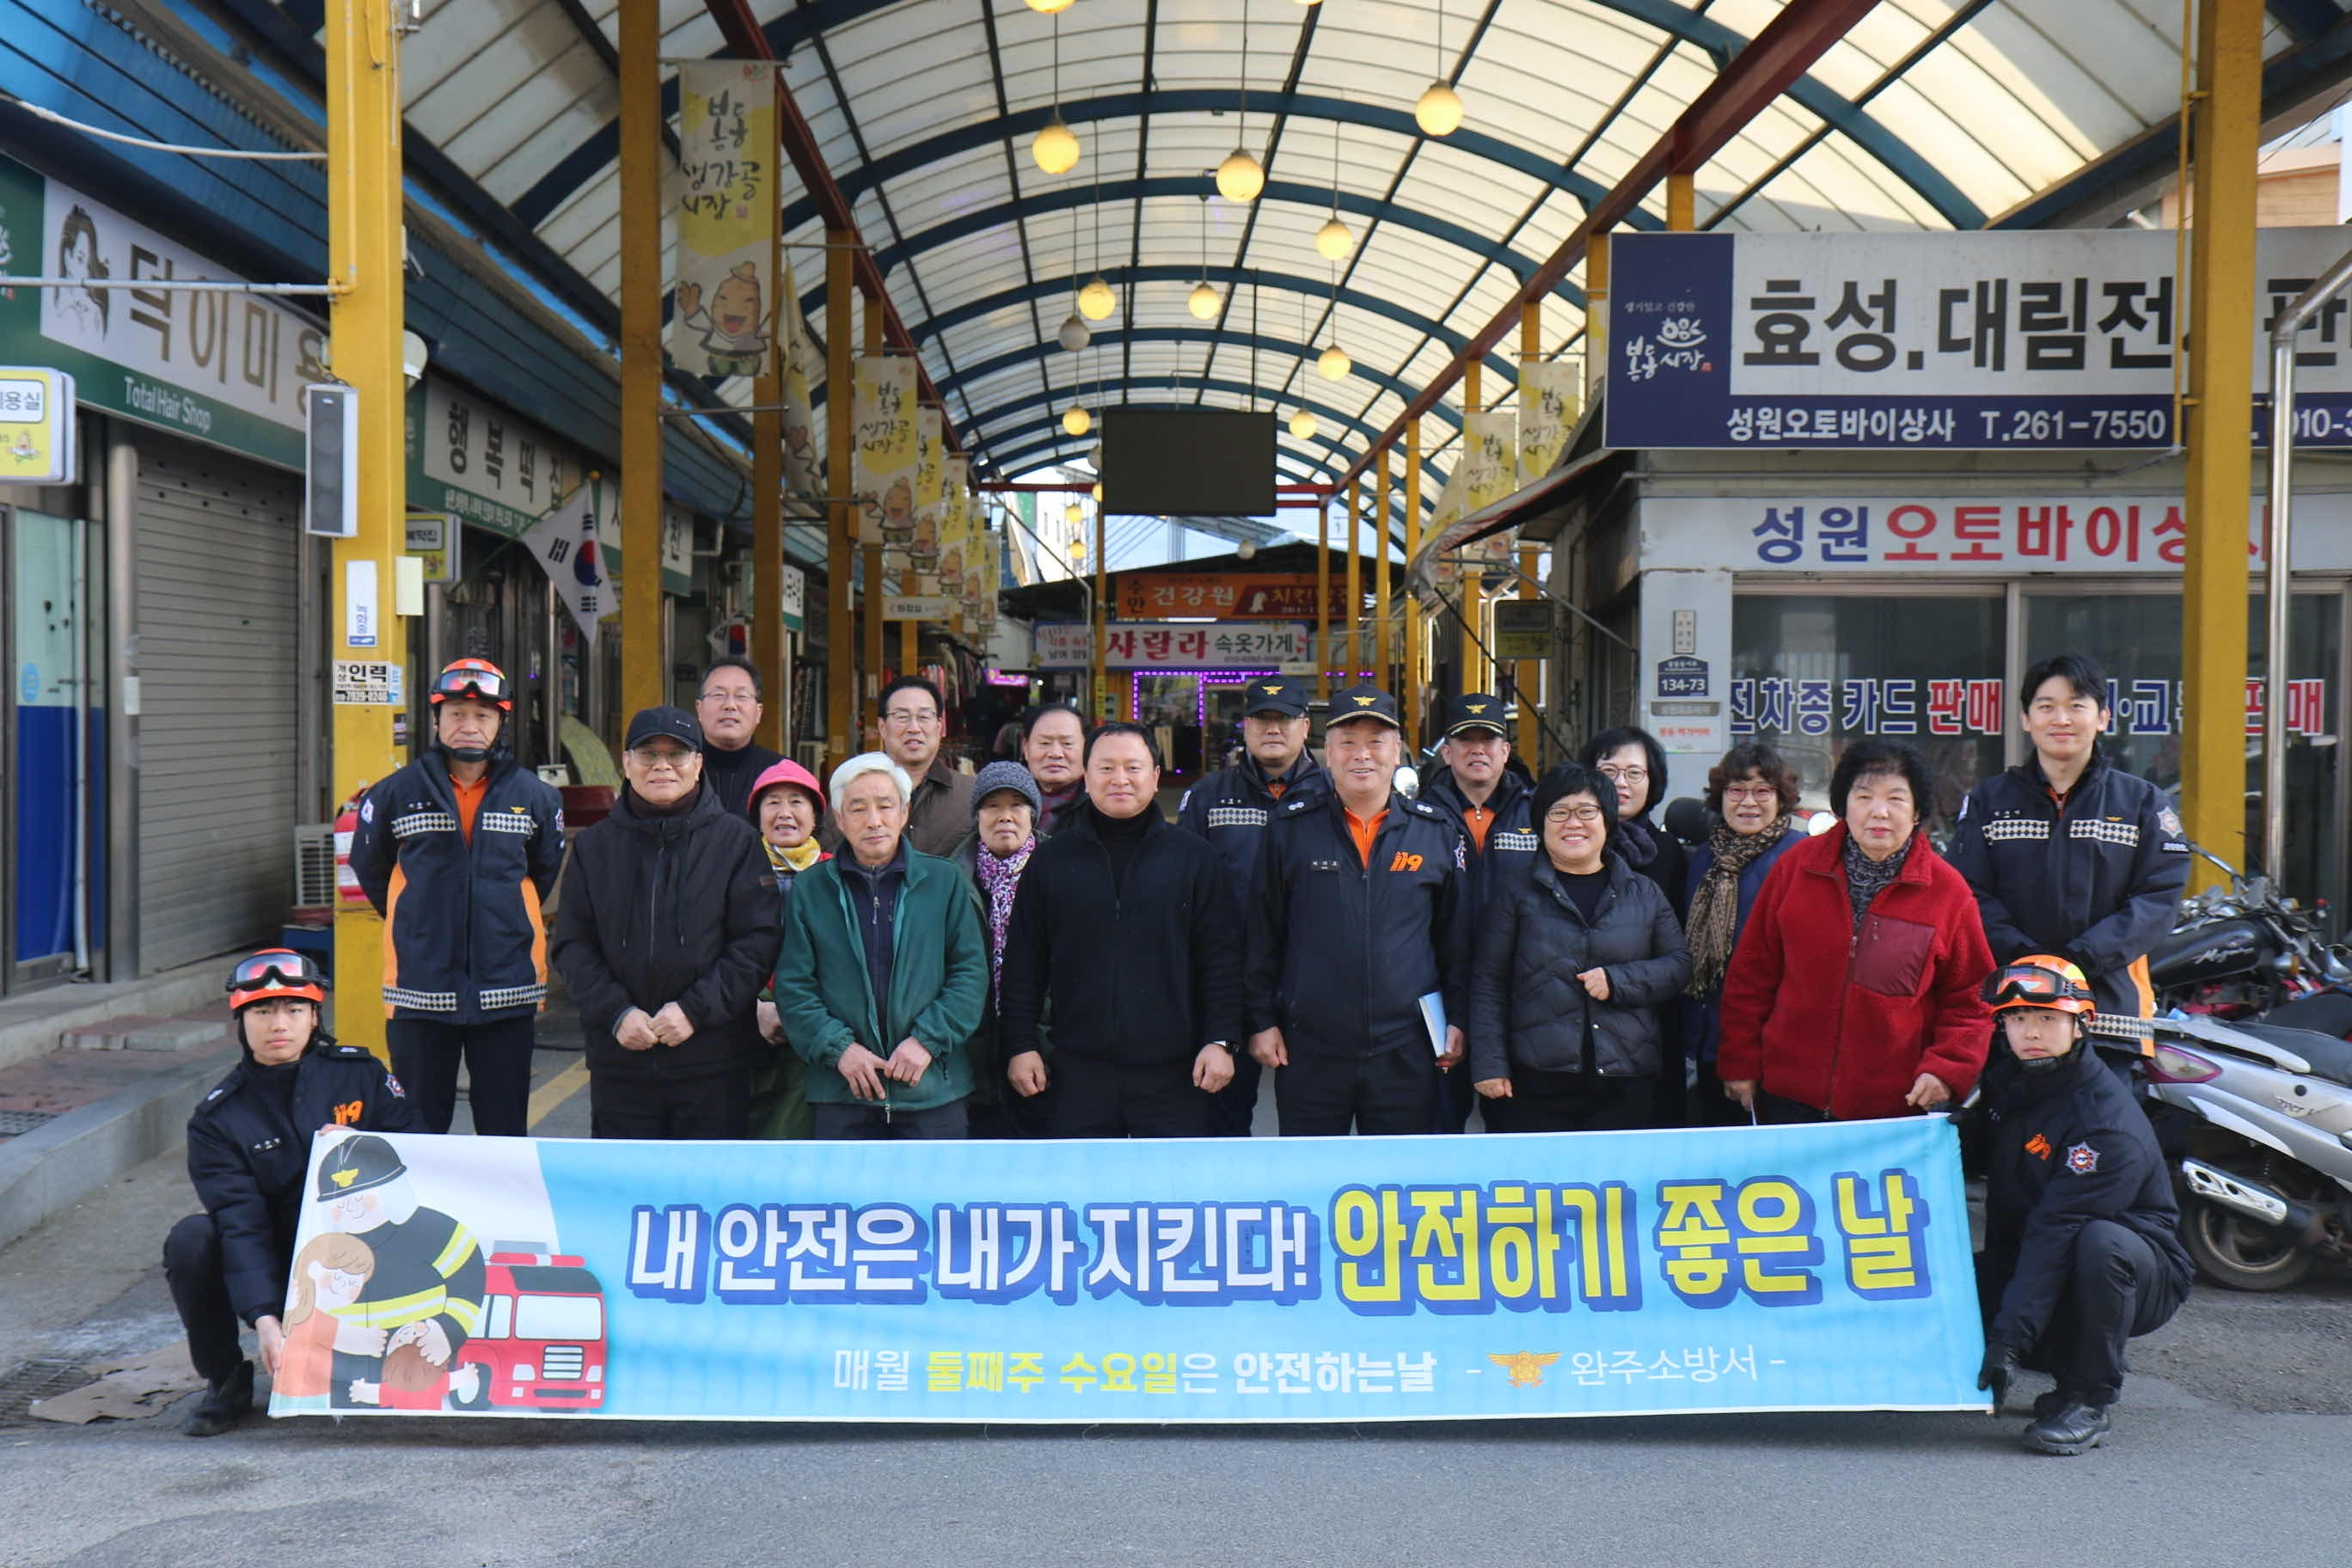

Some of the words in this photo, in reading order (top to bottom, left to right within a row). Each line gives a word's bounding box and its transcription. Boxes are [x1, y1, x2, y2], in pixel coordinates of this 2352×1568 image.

[682, 160, 762, 200] 생강골
[682, 193, 732, 221] 시장
[0, 390, 41, 413] 용실
[124, 376, 160, 411] Total
[159, 388, 181, 422] Hair
[181, 395, 212, 433] Shop
[1726, 407, 1957, 443] 성원오토바이상사
[1980, 408, 2166, 442] T.261-7550
[1153, 585, 1234, 607] 건강원
[1106, 629, 1210, 661] 샤랄라
[1215, 633, 1294, 654] 속옷가게
[349, 664, 387, 683] 인력
[1661, 678, 1706, 691] 134-73
[1841, 677, 1915, 735] 카드
[1927, 677, 2002, 736] 판매
[1389, 853, 1424, 872] 119
[628, 1205, 707, 1296] 내
[716, 1205, 923, 1296] 안전은
[934, 1204, 1078, 1296] 내가
[1086, 1204, 1308, 1296] 지킨다!
[1331, 1184, 1630, 1304] 안전하기
[1657, 1179, 1811, 1298] 좋은
[1834, 1173, 1920, 1291] 날
[834, 1350, 910, 1392] 매월
[925, 1351, 1044, 1393] 둘째주
[1058, 1351, 1217, 1394] 수요일은
[1234, 1350, 1438, 1394] 안전하는날
[1570, 1343, 1758, 1387] 완주소방서
